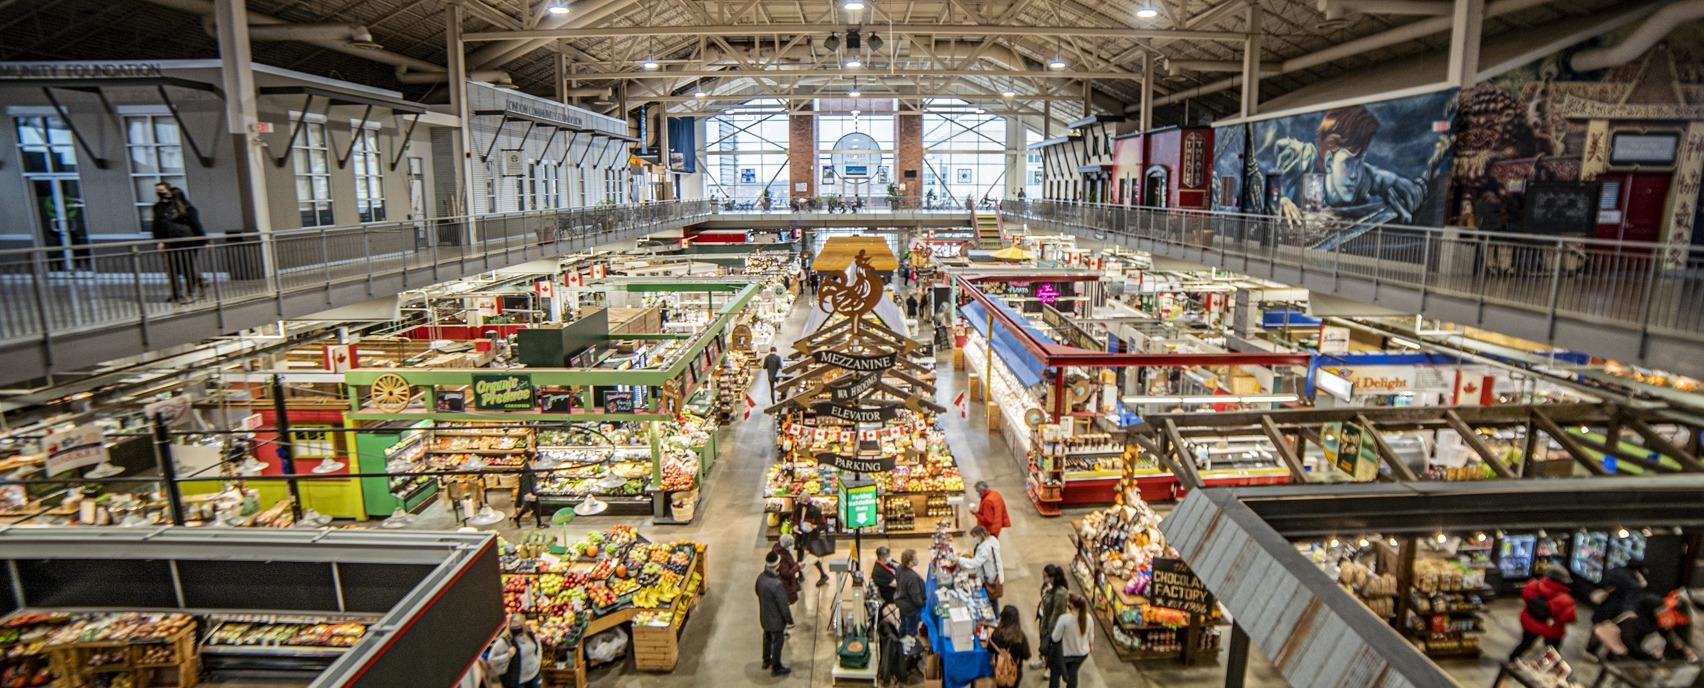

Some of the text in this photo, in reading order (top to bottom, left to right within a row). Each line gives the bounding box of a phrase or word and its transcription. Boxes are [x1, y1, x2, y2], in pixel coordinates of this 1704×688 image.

[65, 62, 161, 77] FOUNDATION
[821, 352, 891, 370] MEZZANINE
[476, 377, 519, 395] Organic
[837, 374, 878, 399] WAHROOMS
[1363, 376, 1407, 390] Delight
[481, 389, 530, 406] Produce
[831, 406, 881, 422] ELEVATOR
[834, 457, 881, 472] PARKING
[1154, 584, 1208, 602] FACTORY
